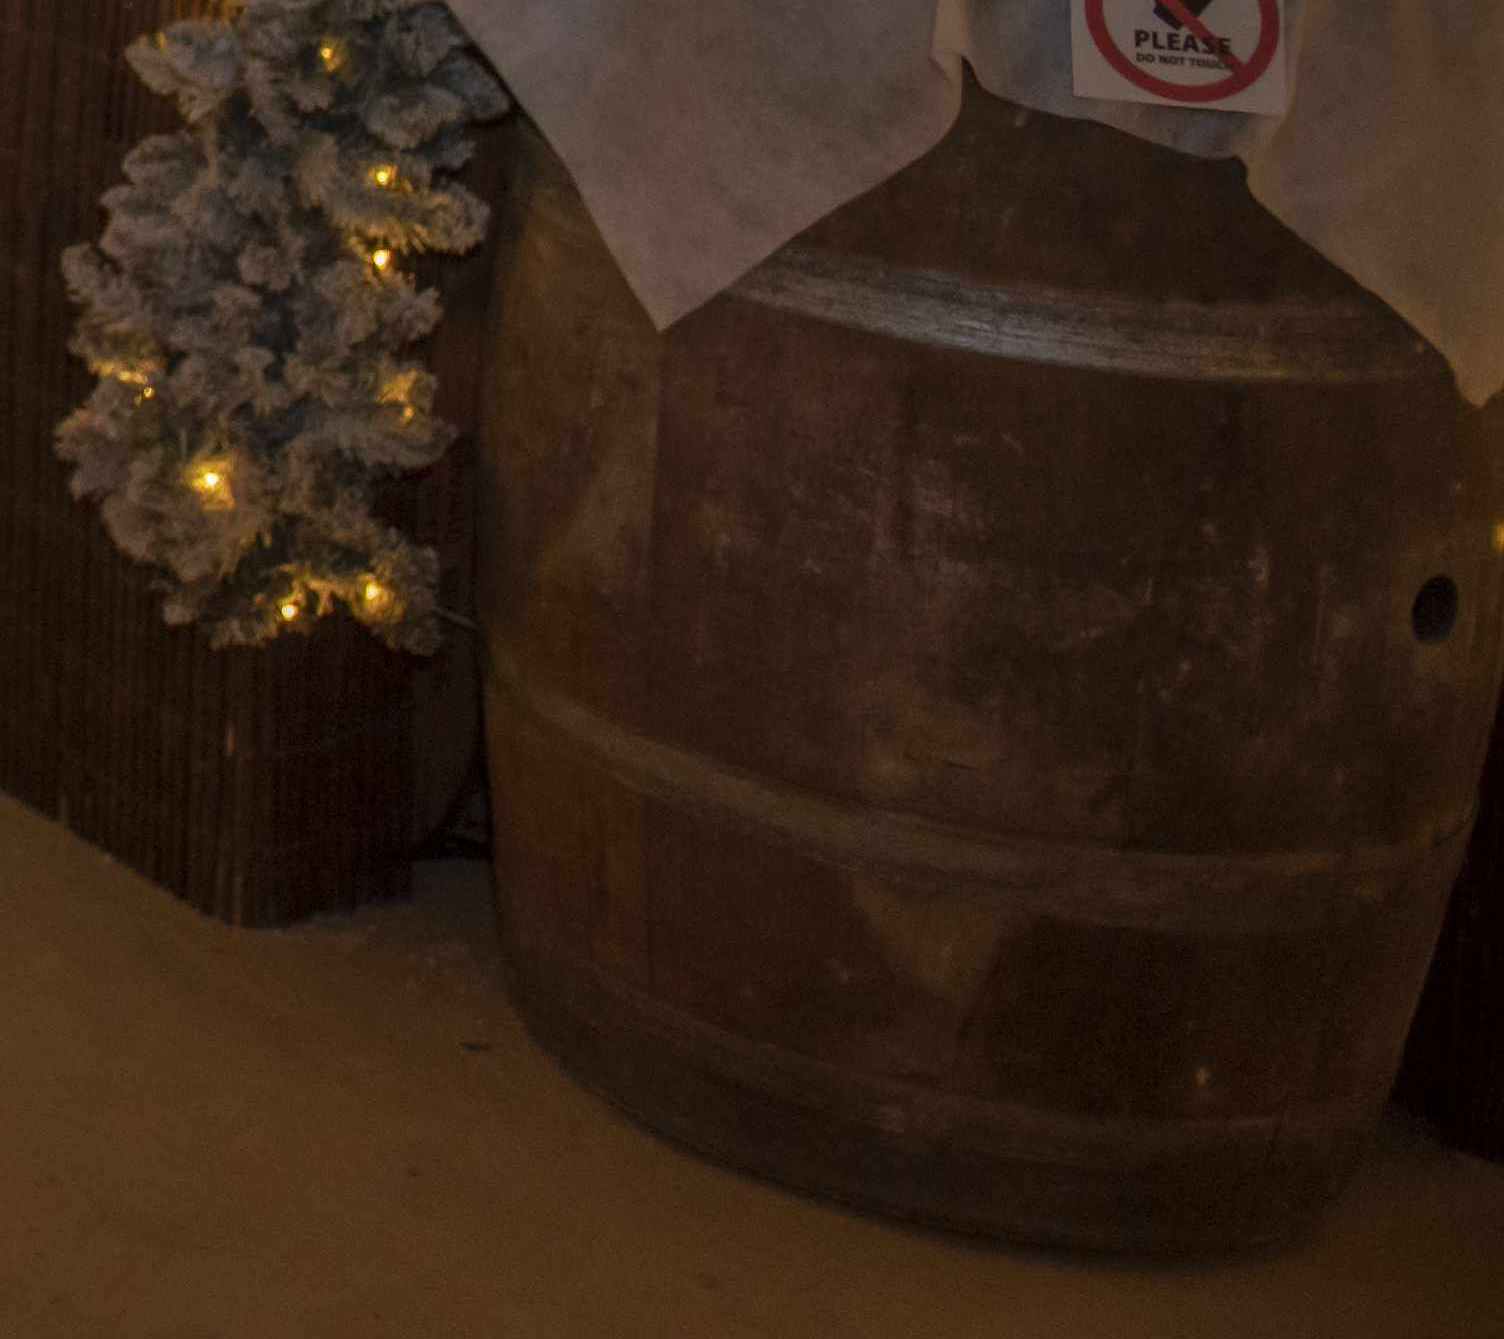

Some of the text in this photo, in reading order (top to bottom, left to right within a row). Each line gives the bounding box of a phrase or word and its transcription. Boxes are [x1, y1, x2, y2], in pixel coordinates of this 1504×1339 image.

[1135, 29, 1232, 56] PLEASE
[1136, 52, 1155, 63] DO
[1158, 54, 1185, 65] NOT
